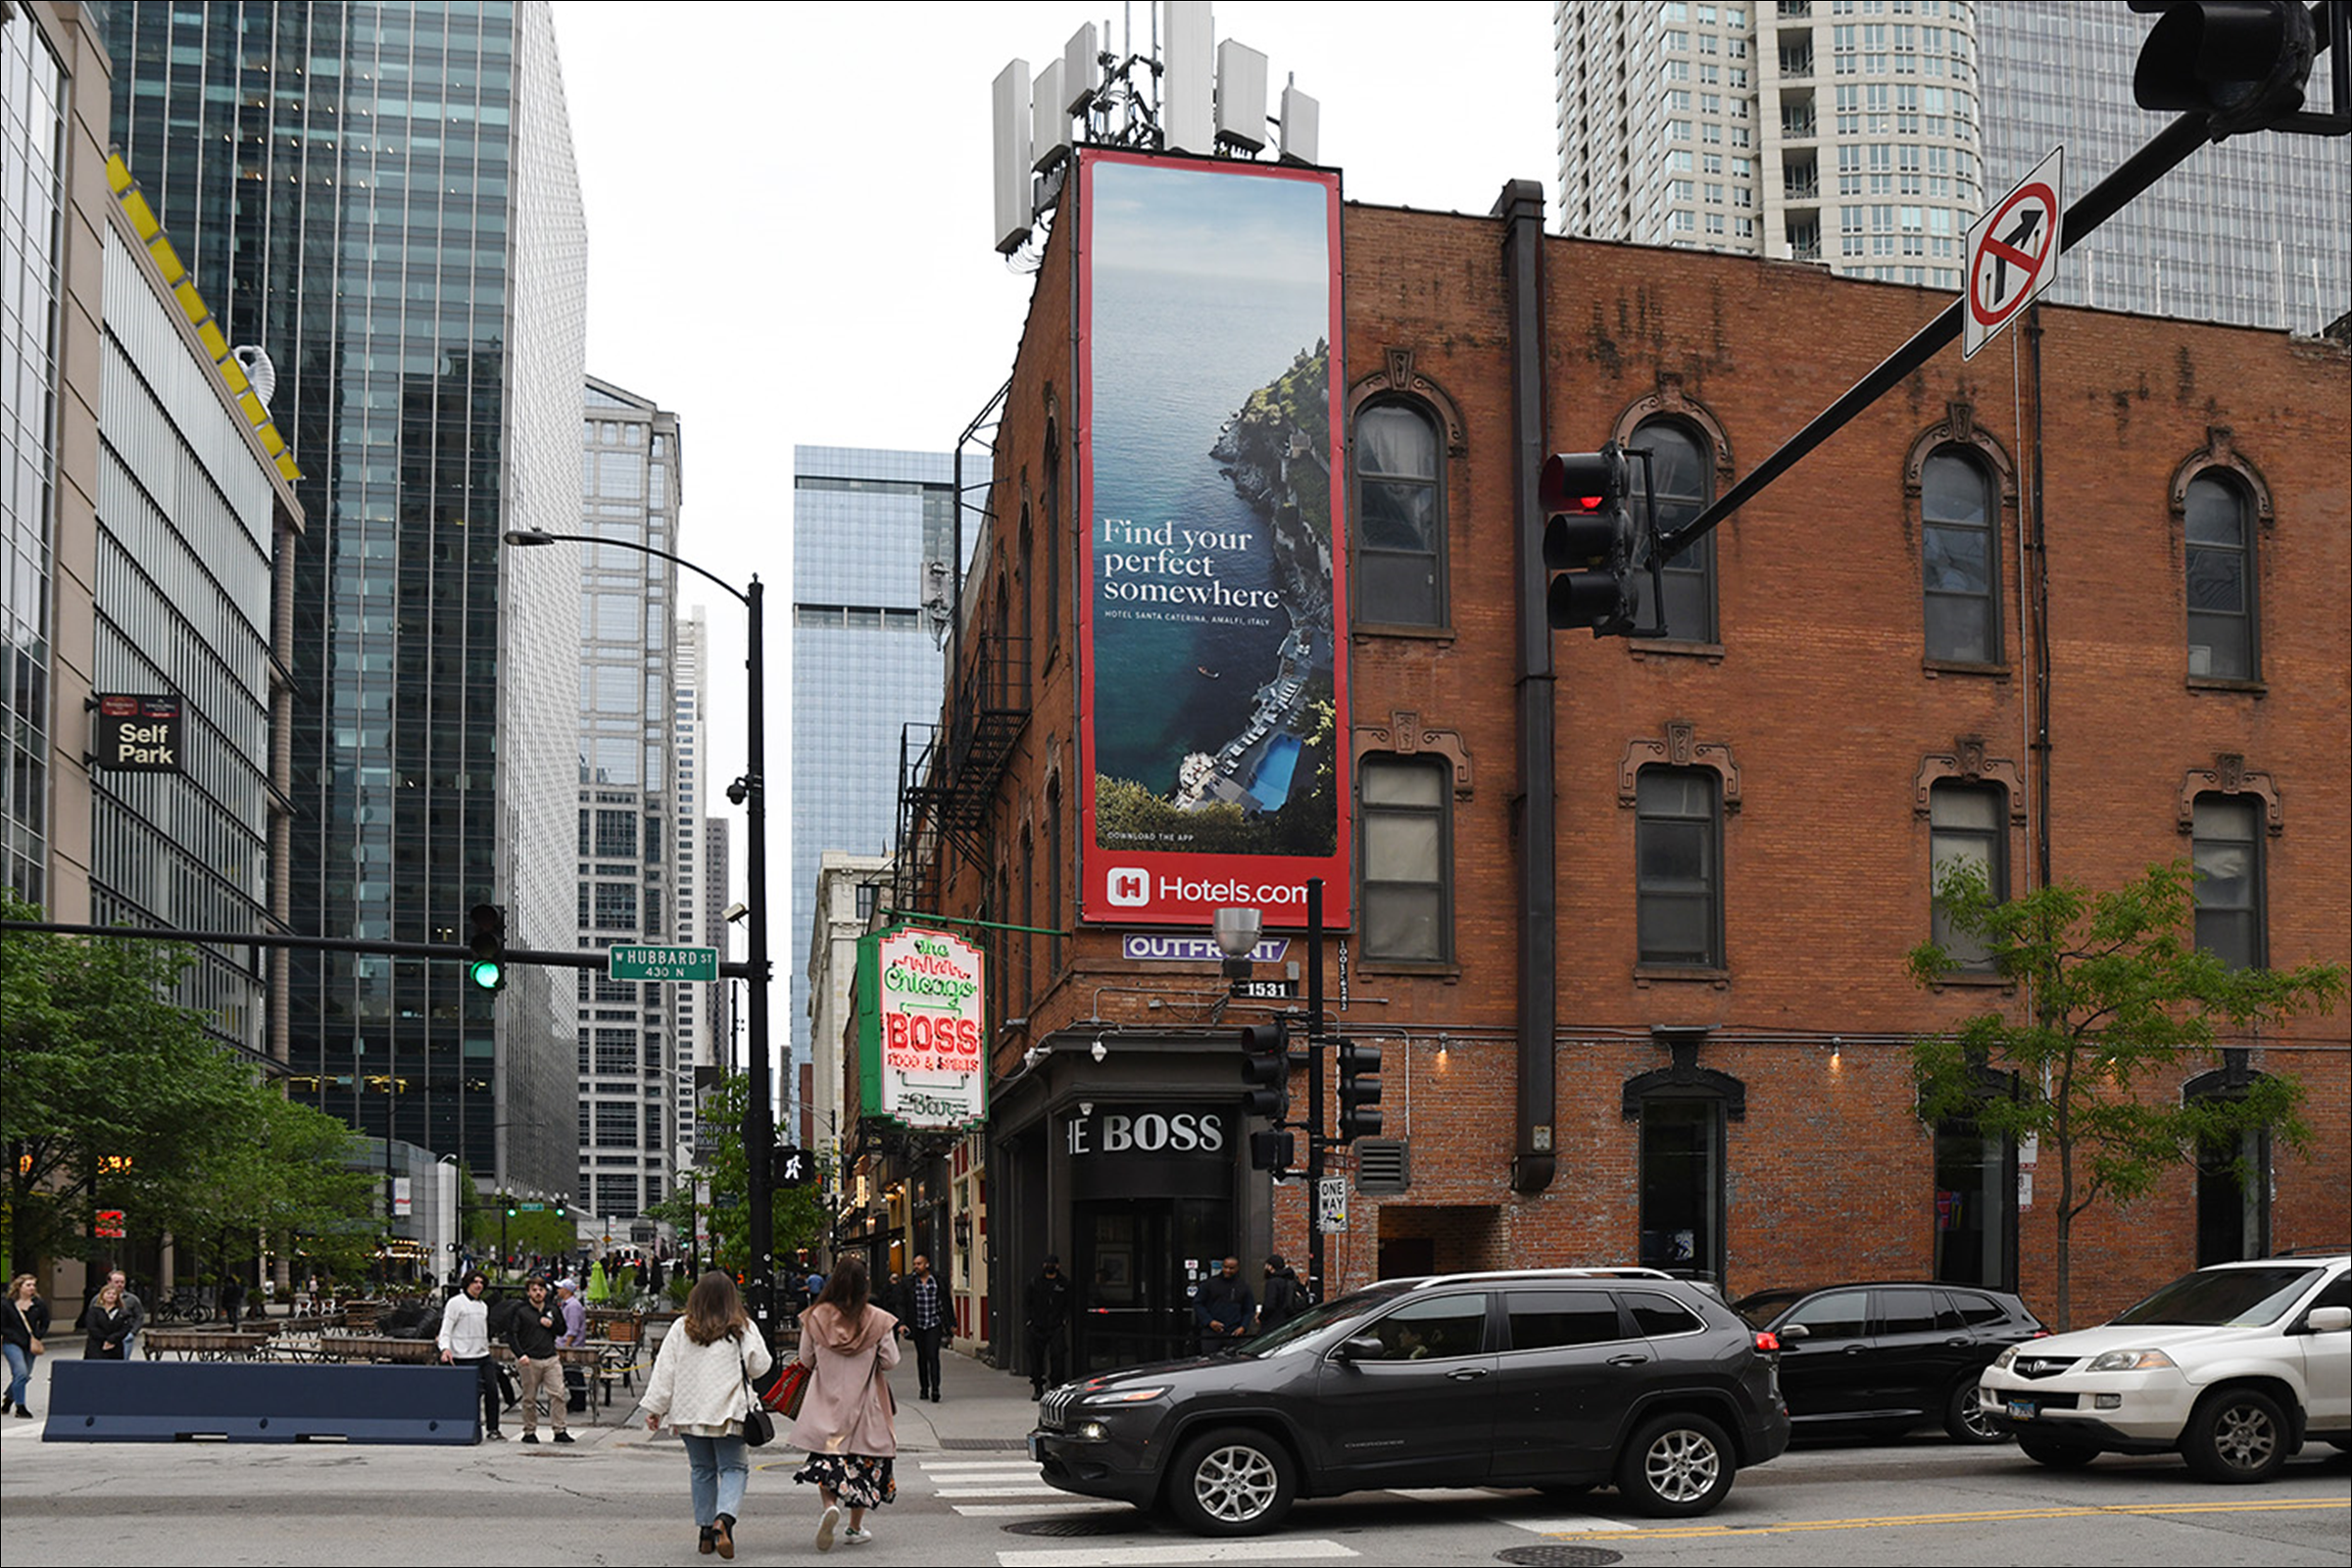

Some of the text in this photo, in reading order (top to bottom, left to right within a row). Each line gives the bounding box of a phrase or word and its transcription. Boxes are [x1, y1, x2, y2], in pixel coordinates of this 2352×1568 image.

[1103, 518, 1253, 554] Find your
[1103, 548, 1215, 578] perfect
[1103, 580, 1280, 609] somewhere
[1104, 610, 1270, 626] HOTEL SANTA CATERINA, AMALFI, ITALY
[119, 722, 169, 744] Self
[119, 744, 173, 764] Park
[1106, 831, 1195, 842] DOWNLOAD THE APP
[1159, 876, 1309, 904] Hotels.com
[615, 950, 712, 965] W HUBBARD ST
[913, 938, 951, 957] The
[1129, 937, 1281, 959] OUTFRNT
[645, 967, 684, 977] 430 N
[884, 965, 978, 1007] Chicago
[1248, 983, 1286, 997] 1531
[886, 1011, 978, 1056] BOSS
[888, 1053, 920, 1068] FOOD
[909, 1093, 955, 1116] Bar
[1103, 1113, 1223, 1152] BOSS
[1321, 1181, 1344, 1196] ONE
